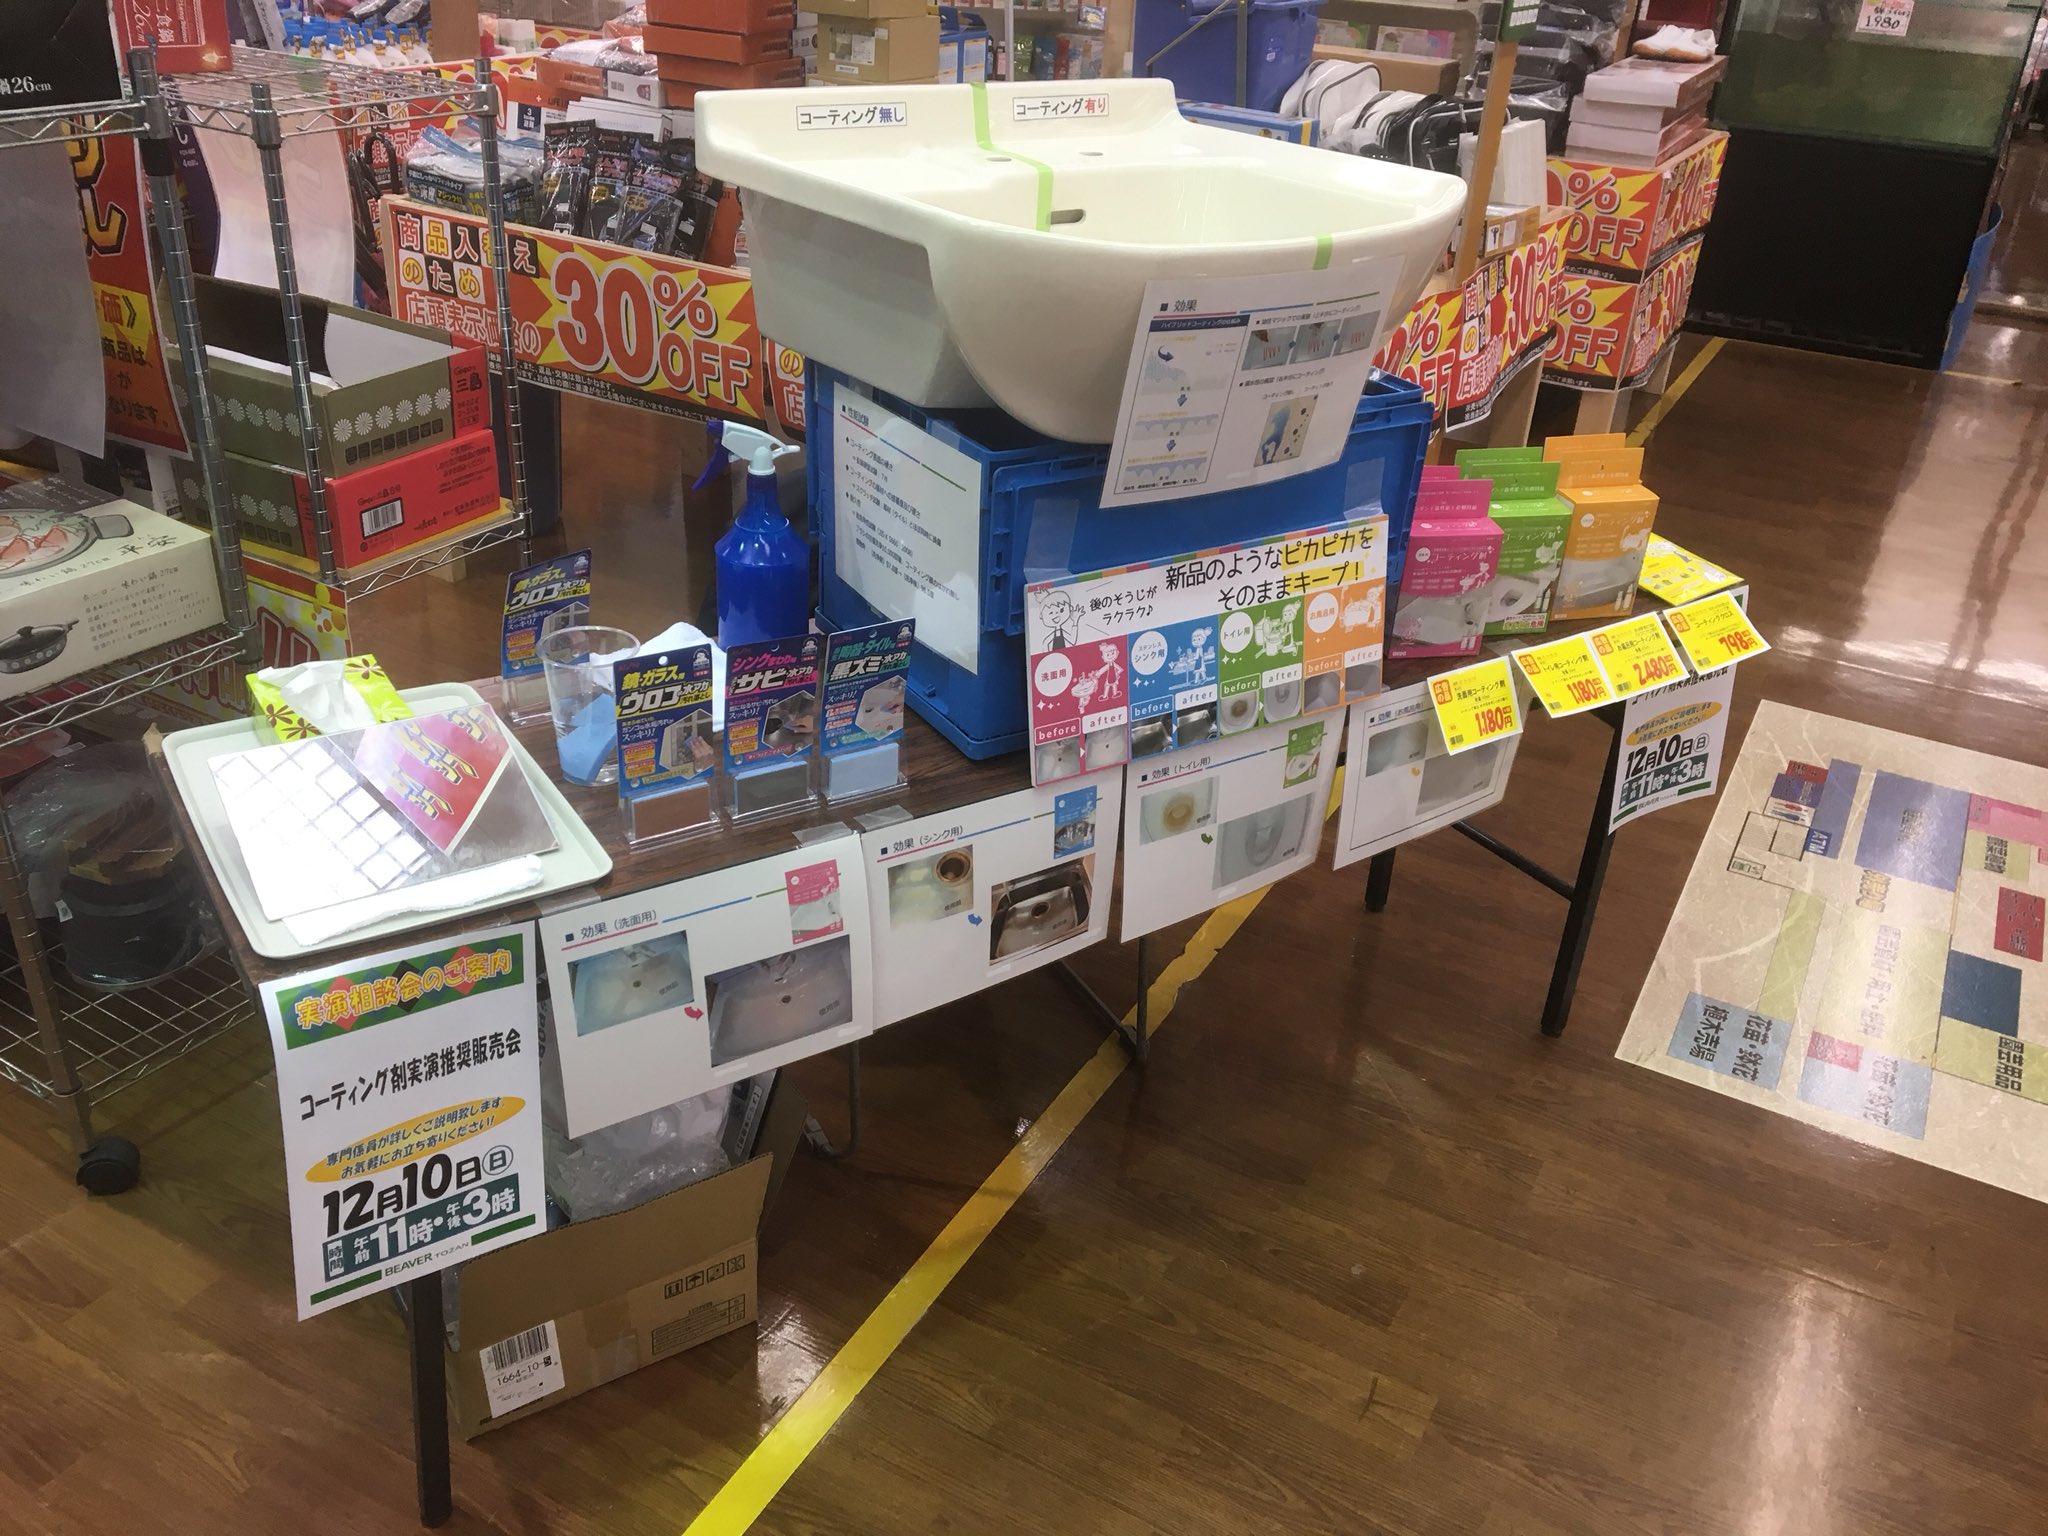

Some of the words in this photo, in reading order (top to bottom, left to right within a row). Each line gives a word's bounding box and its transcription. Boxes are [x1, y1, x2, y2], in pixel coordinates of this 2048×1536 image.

[1866, 15, 1900, 29] 1980
[799, 106, 905, 126] コーティング無し
[1016, 97, 1106, 117] コーティング有り
[1565, 214, 1644, 260] OFF
[401, 257, 484, 299] のため
[551, 251, 718, 385] 30%
[1173, 299, 1198, 314] 効果
[658, 330, 751, 405] OFF
[1165, 527, 1374, 591] 新品のようなピカピカを
[510, 581, 560, 611] ウロコ
[1089, 584, 1158, 612] 後のそうじが
[1222, 625, 1252, 642] トイレ用
[829, 654, 882, 681] 黒ズミ
[1134, 646, 1166, 665] シンク用
[1308, 656, 1341, 673] before
[1350, 648, 1379, 662] after
[1542, 654, 1590, 673] トイレ用コーティング剤
[735, 668, 787, 694] サビ
[1040, 666, 1067, 682] 洗面用
[1223, 678, 1258, 695] before
[1267, 668, 1298, 683] after
[621, 686, 681, 716] ウロコ
[680, 691, 711, 706] 汚れ落とし
[1181, 689, 1214, 705] after
[1456, 679, 1507, 701] 洗面用コーティング剤
[1089, 712, 1123, 727] after
[1134, 699, 1170, 717] before
[1038, 722, 1077, 741] before
[1625, 734, 1694, 780] 12月10日
[893, 824, 963, 853] 効果（シンク用）
[1809, 830, 1832, 856] ATM
[580, 909, 657, 940] 効果（洗面用）
[294, 947, 513, 1030] 実演相談会のご案内
[1688, 1004, 1728, 1064] 植木売場
[299, 1026, 522, 1121] コーティング剤実演推奨販売会
[1995, 1035, 2025, 1092] 園芸用品
[325, 1095, 505, 1168] 専門係員が詳しくご説明致します。
[322, 1153, 482, 1238] 12月10日
[327, 1237, 345, 1276] 時間
[384, 1252, 433, 1277] BEAVER
[434, 1241, 470, 1259] TOZAN
